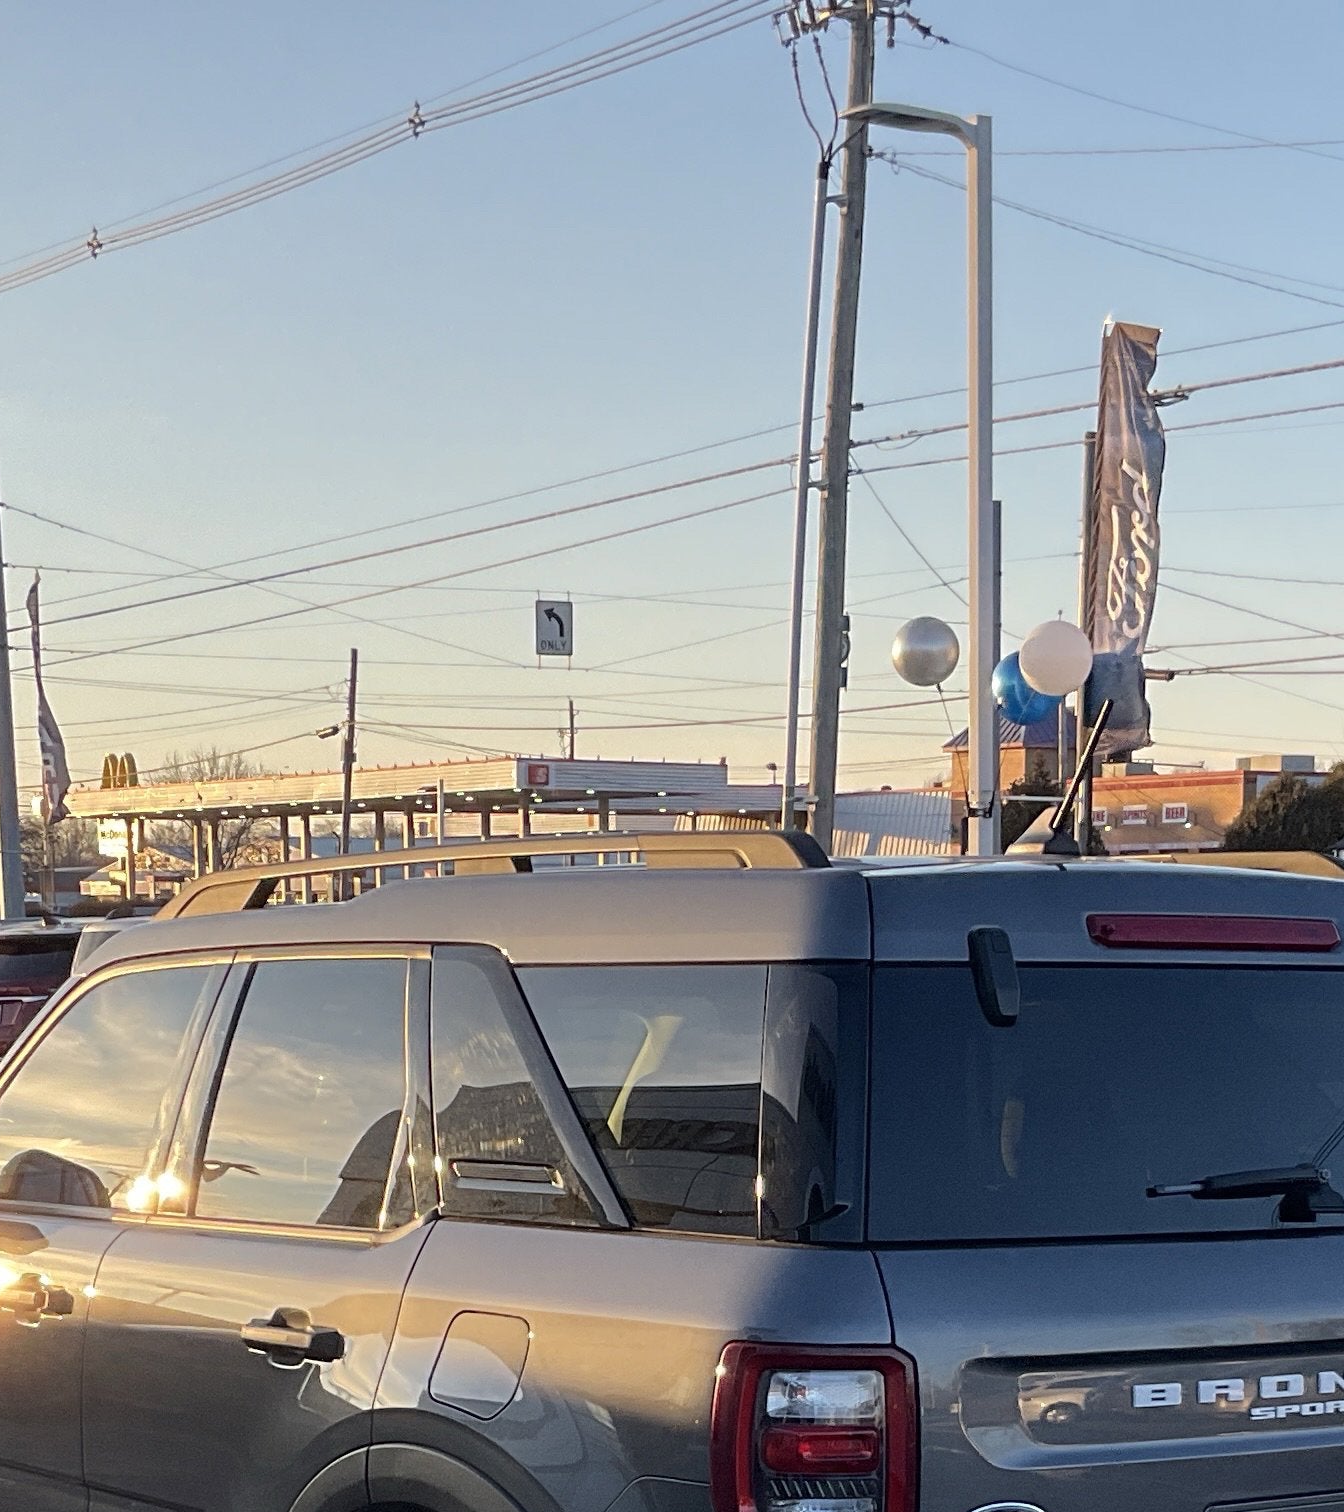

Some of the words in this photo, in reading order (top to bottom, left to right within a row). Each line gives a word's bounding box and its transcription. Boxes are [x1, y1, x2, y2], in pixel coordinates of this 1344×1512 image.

[1106, 458, 1158, 639] Ford
[540, 640, 567, 651] ONLY
[1165, 806, 1186, 820] BEER
